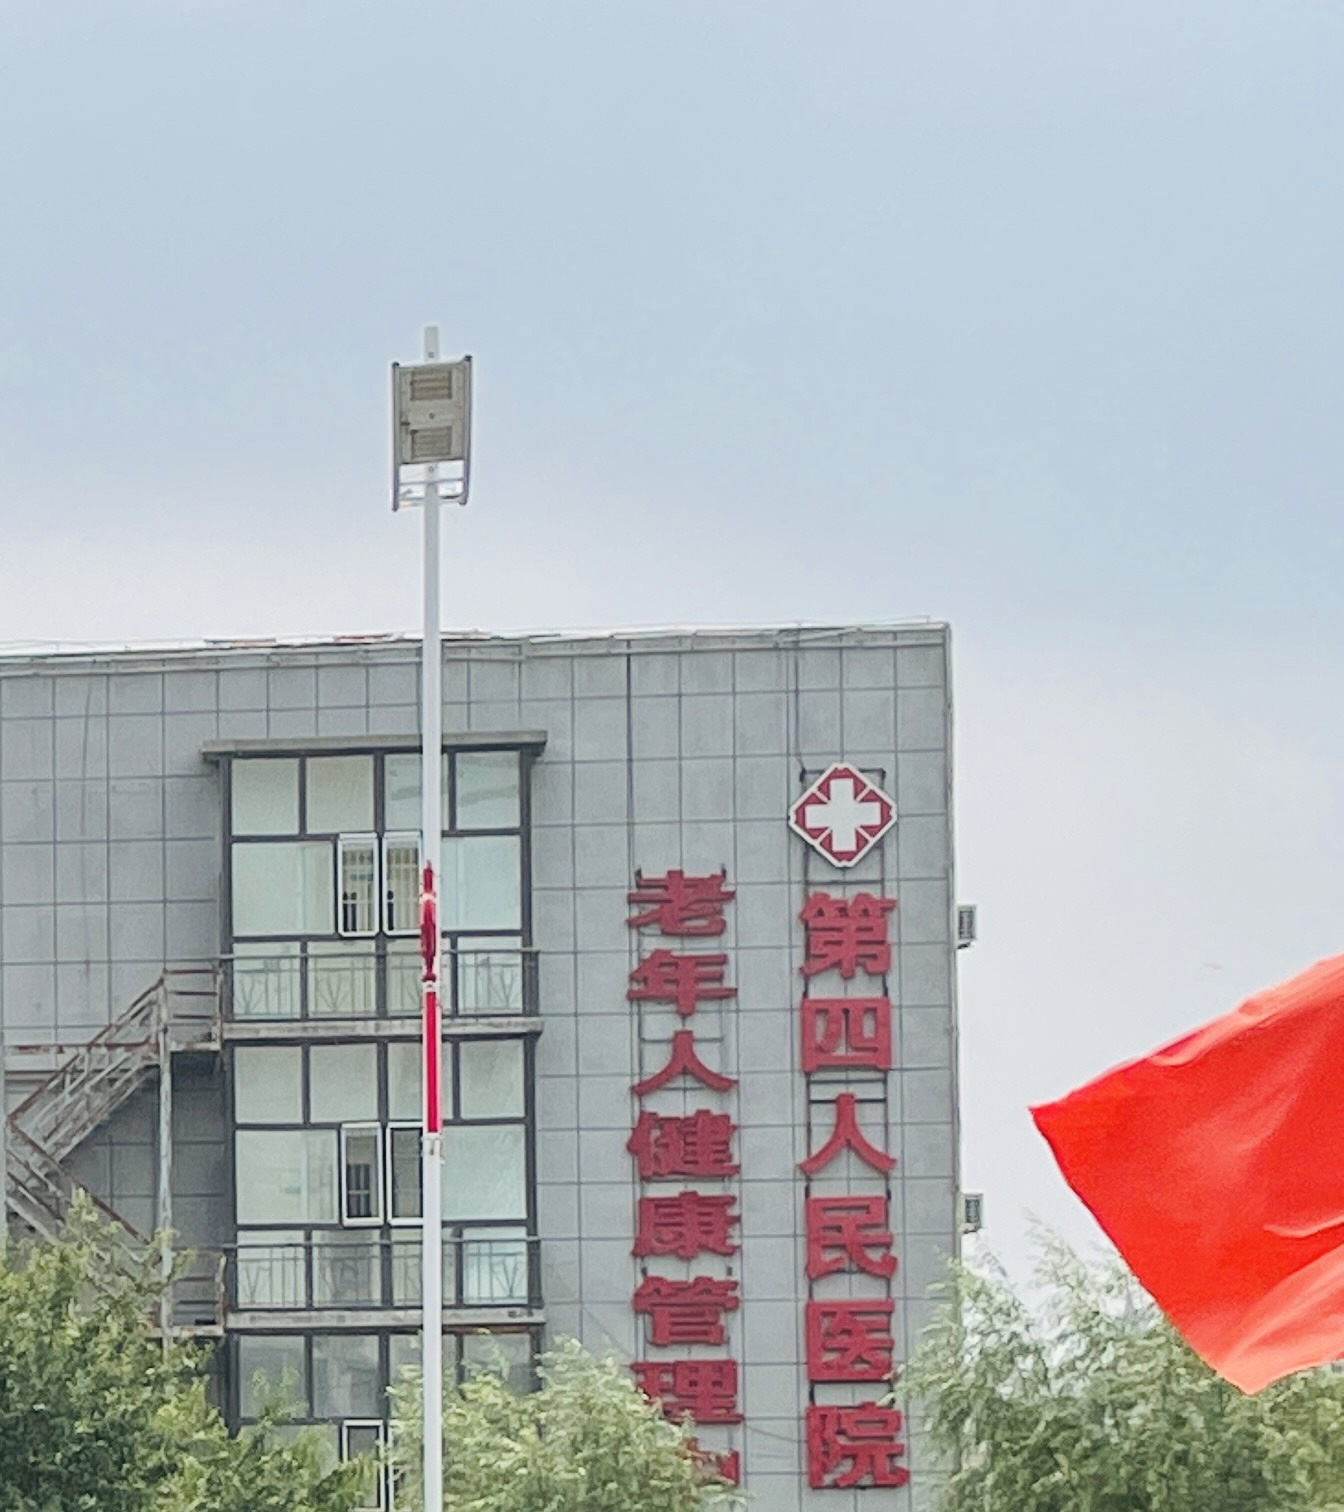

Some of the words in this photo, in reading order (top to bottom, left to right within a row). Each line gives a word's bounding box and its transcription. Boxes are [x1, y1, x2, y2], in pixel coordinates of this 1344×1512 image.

[798, 890, 910, 1489] 第四人民医院
